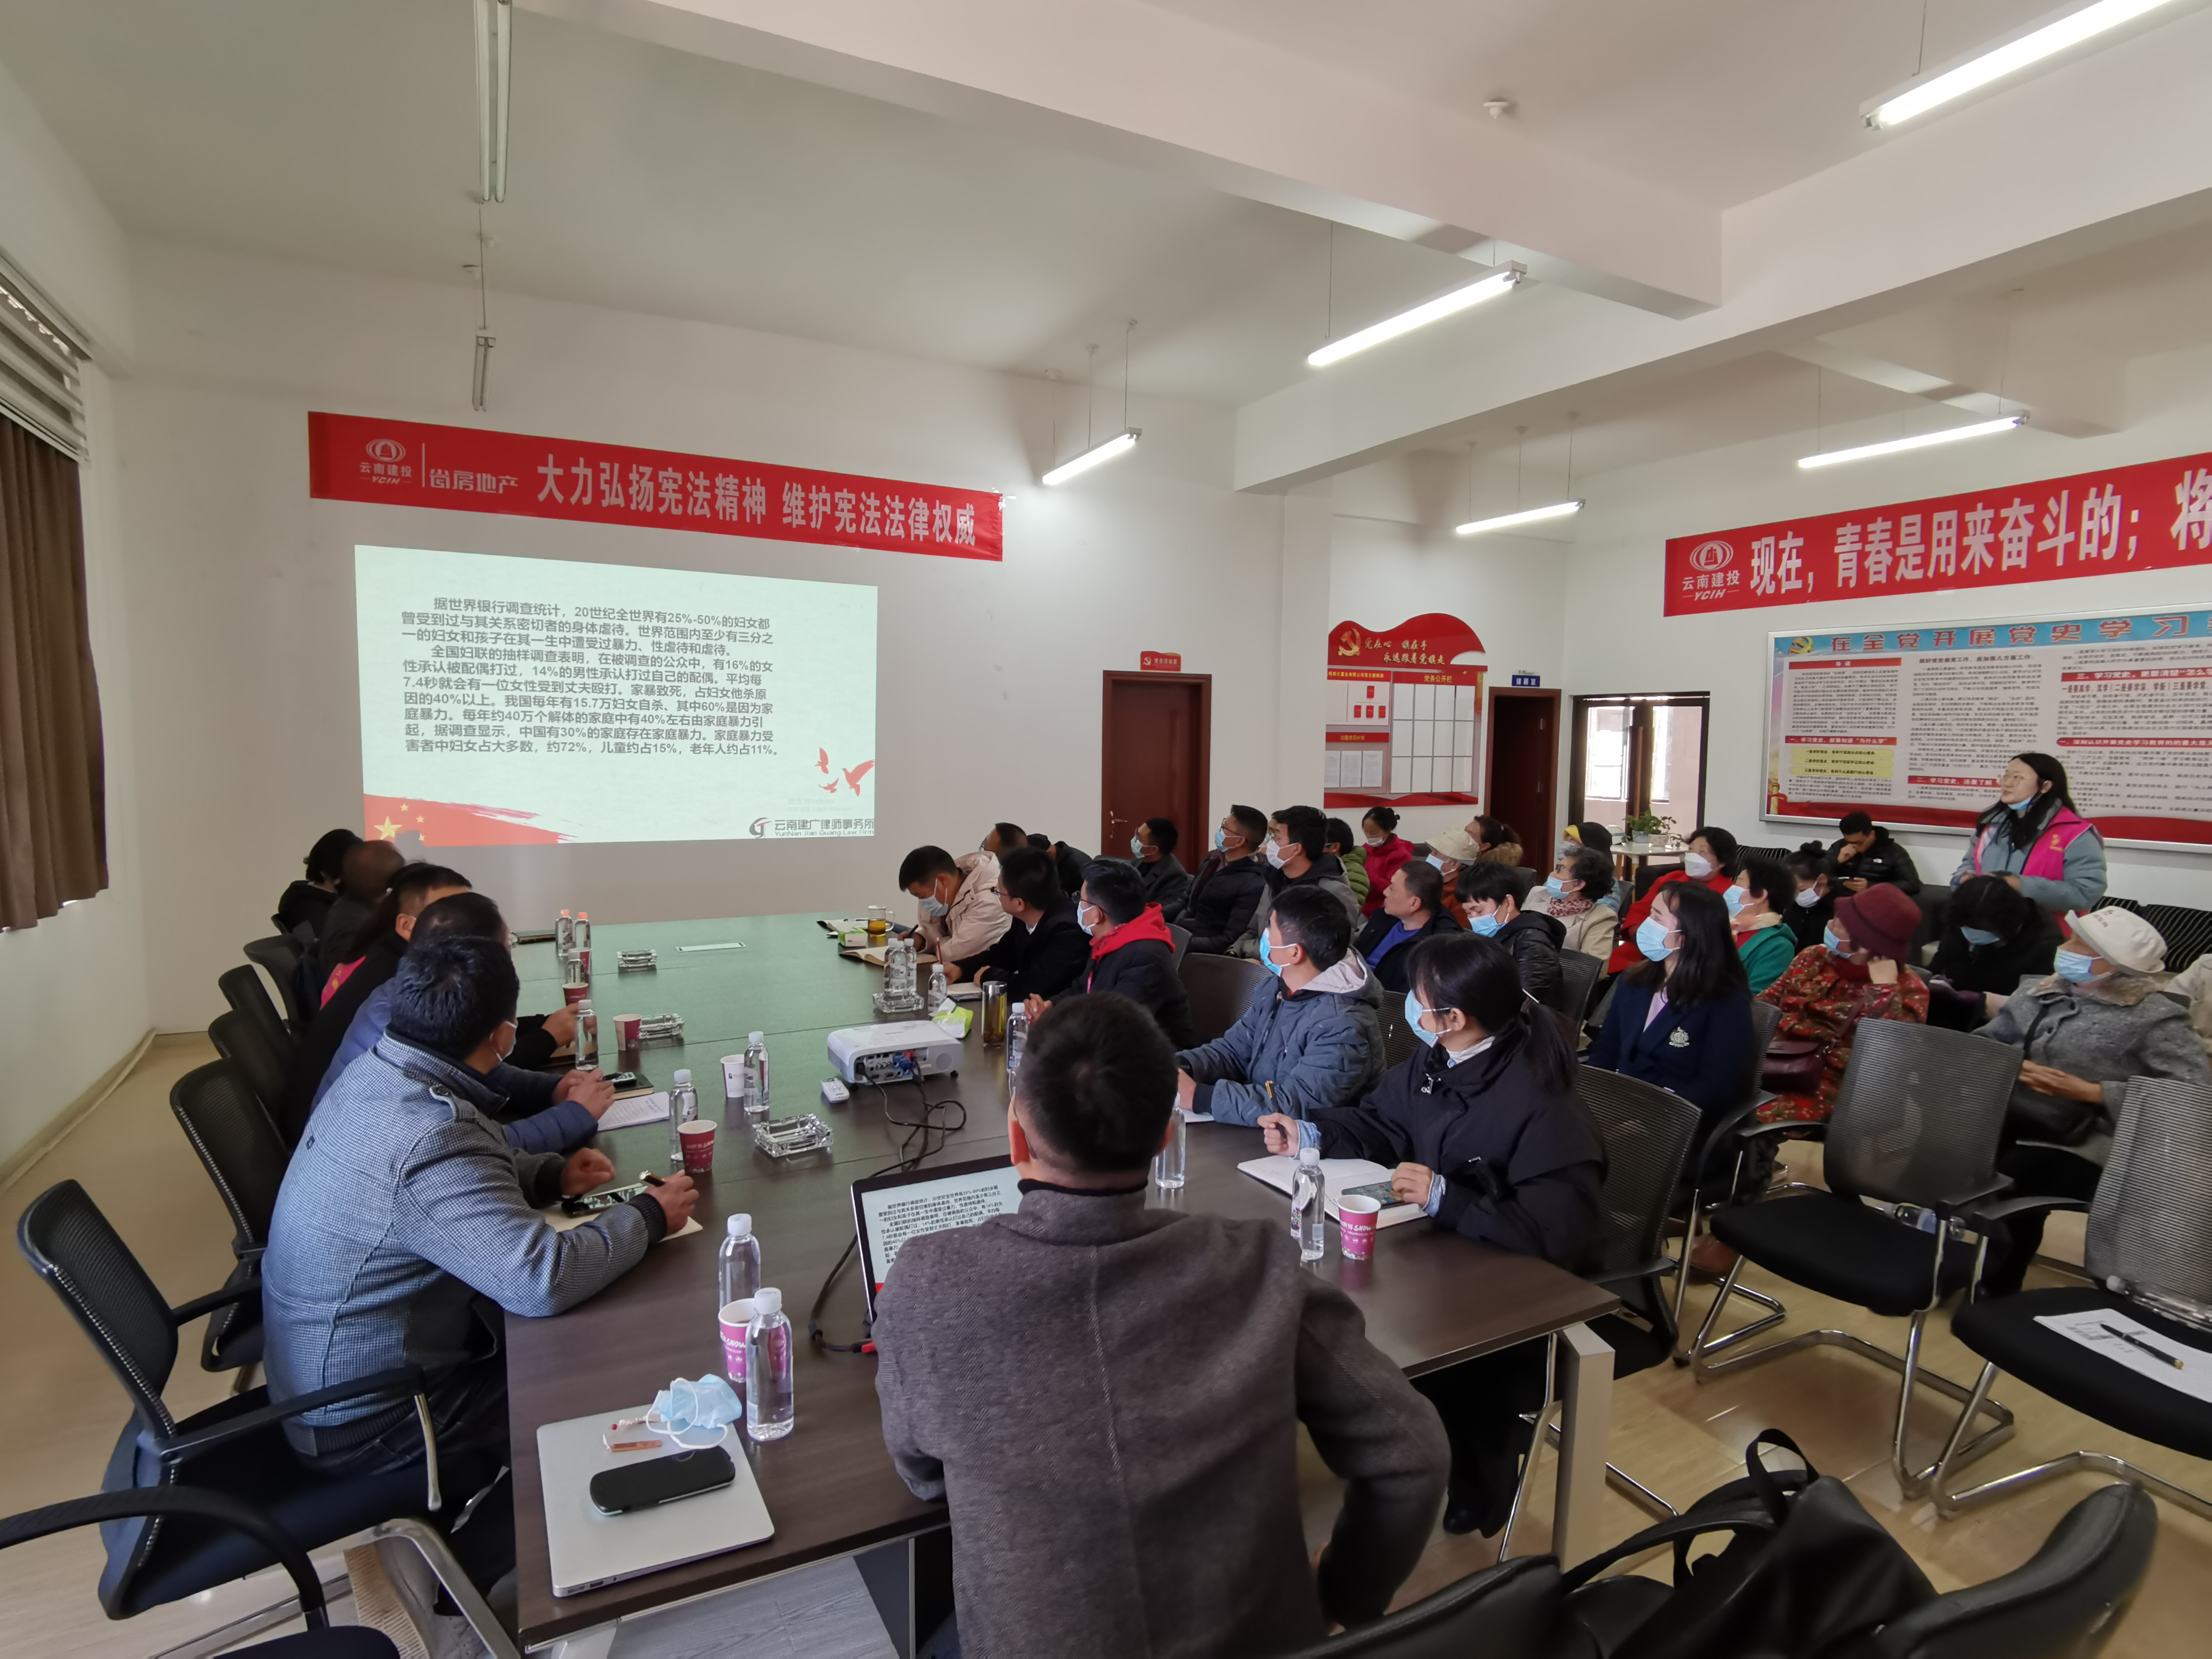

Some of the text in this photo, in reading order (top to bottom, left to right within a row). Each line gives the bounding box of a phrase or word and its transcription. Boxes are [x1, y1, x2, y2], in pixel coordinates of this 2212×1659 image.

[360, 462, 412, 478] 云南建投
[537, 453, 976, 547] 大力弘扬宪法精神 维护宪法法律权威
[1682, 570, 1740, 591] 云南建投
[1694, 589, 1726, 601] YCIH
[1831, 615, 2212, 652] 在全党开展党史学习
